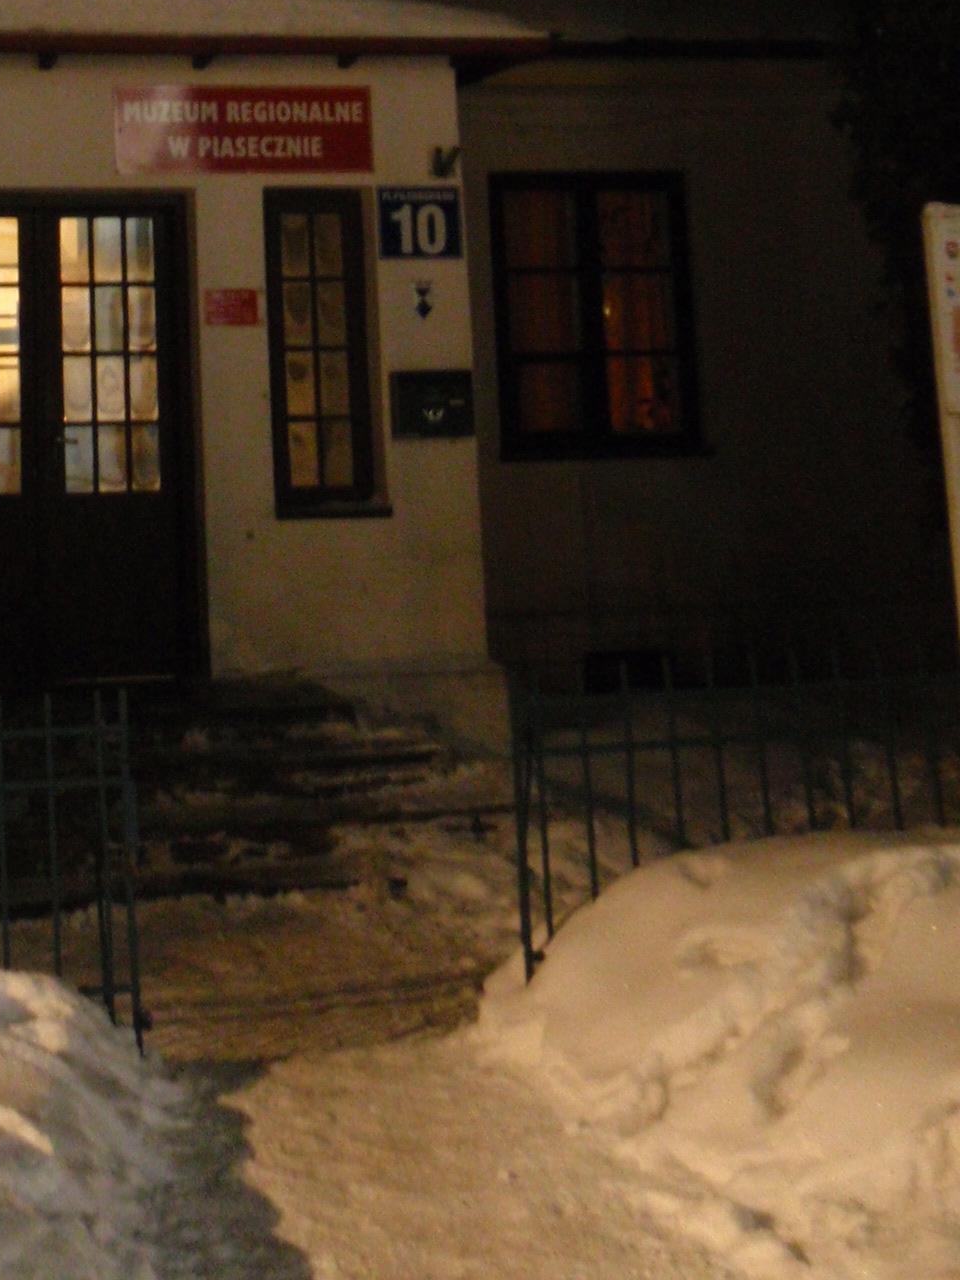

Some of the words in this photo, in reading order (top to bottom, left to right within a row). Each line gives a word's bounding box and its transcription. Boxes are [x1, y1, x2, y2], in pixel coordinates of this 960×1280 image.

[124, 100, 219, 123] MUZEUM
[227, 101, 363, 123] REGIONALNE
[167, 136, 191, 158] W
[201, 136, 323, 158] PIASECZNIE
[391, 203, 447, 254] 10
